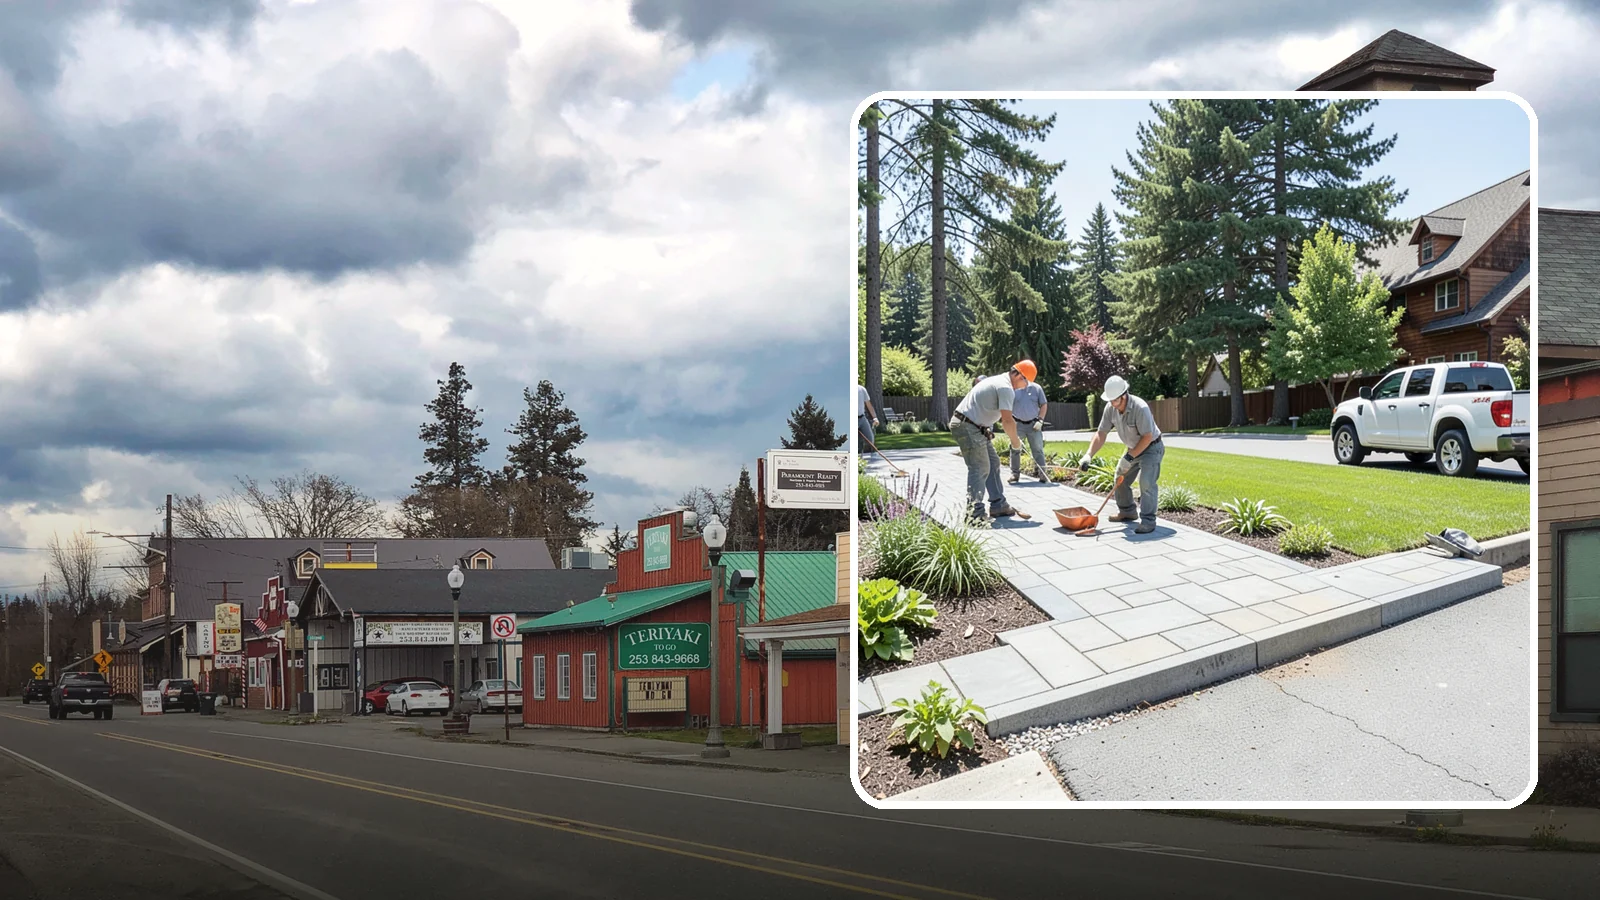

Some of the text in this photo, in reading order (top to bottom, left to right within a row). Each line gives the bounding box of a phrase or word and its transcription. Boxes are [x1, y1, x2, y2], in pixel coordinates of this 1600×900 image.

[817, 472, 839, 480] REALTY
[624, 627, 702, 646] TERIYAKI
[665, 643, 677, 651] GO
[628, 653, 700, 665] 253 843-9668
